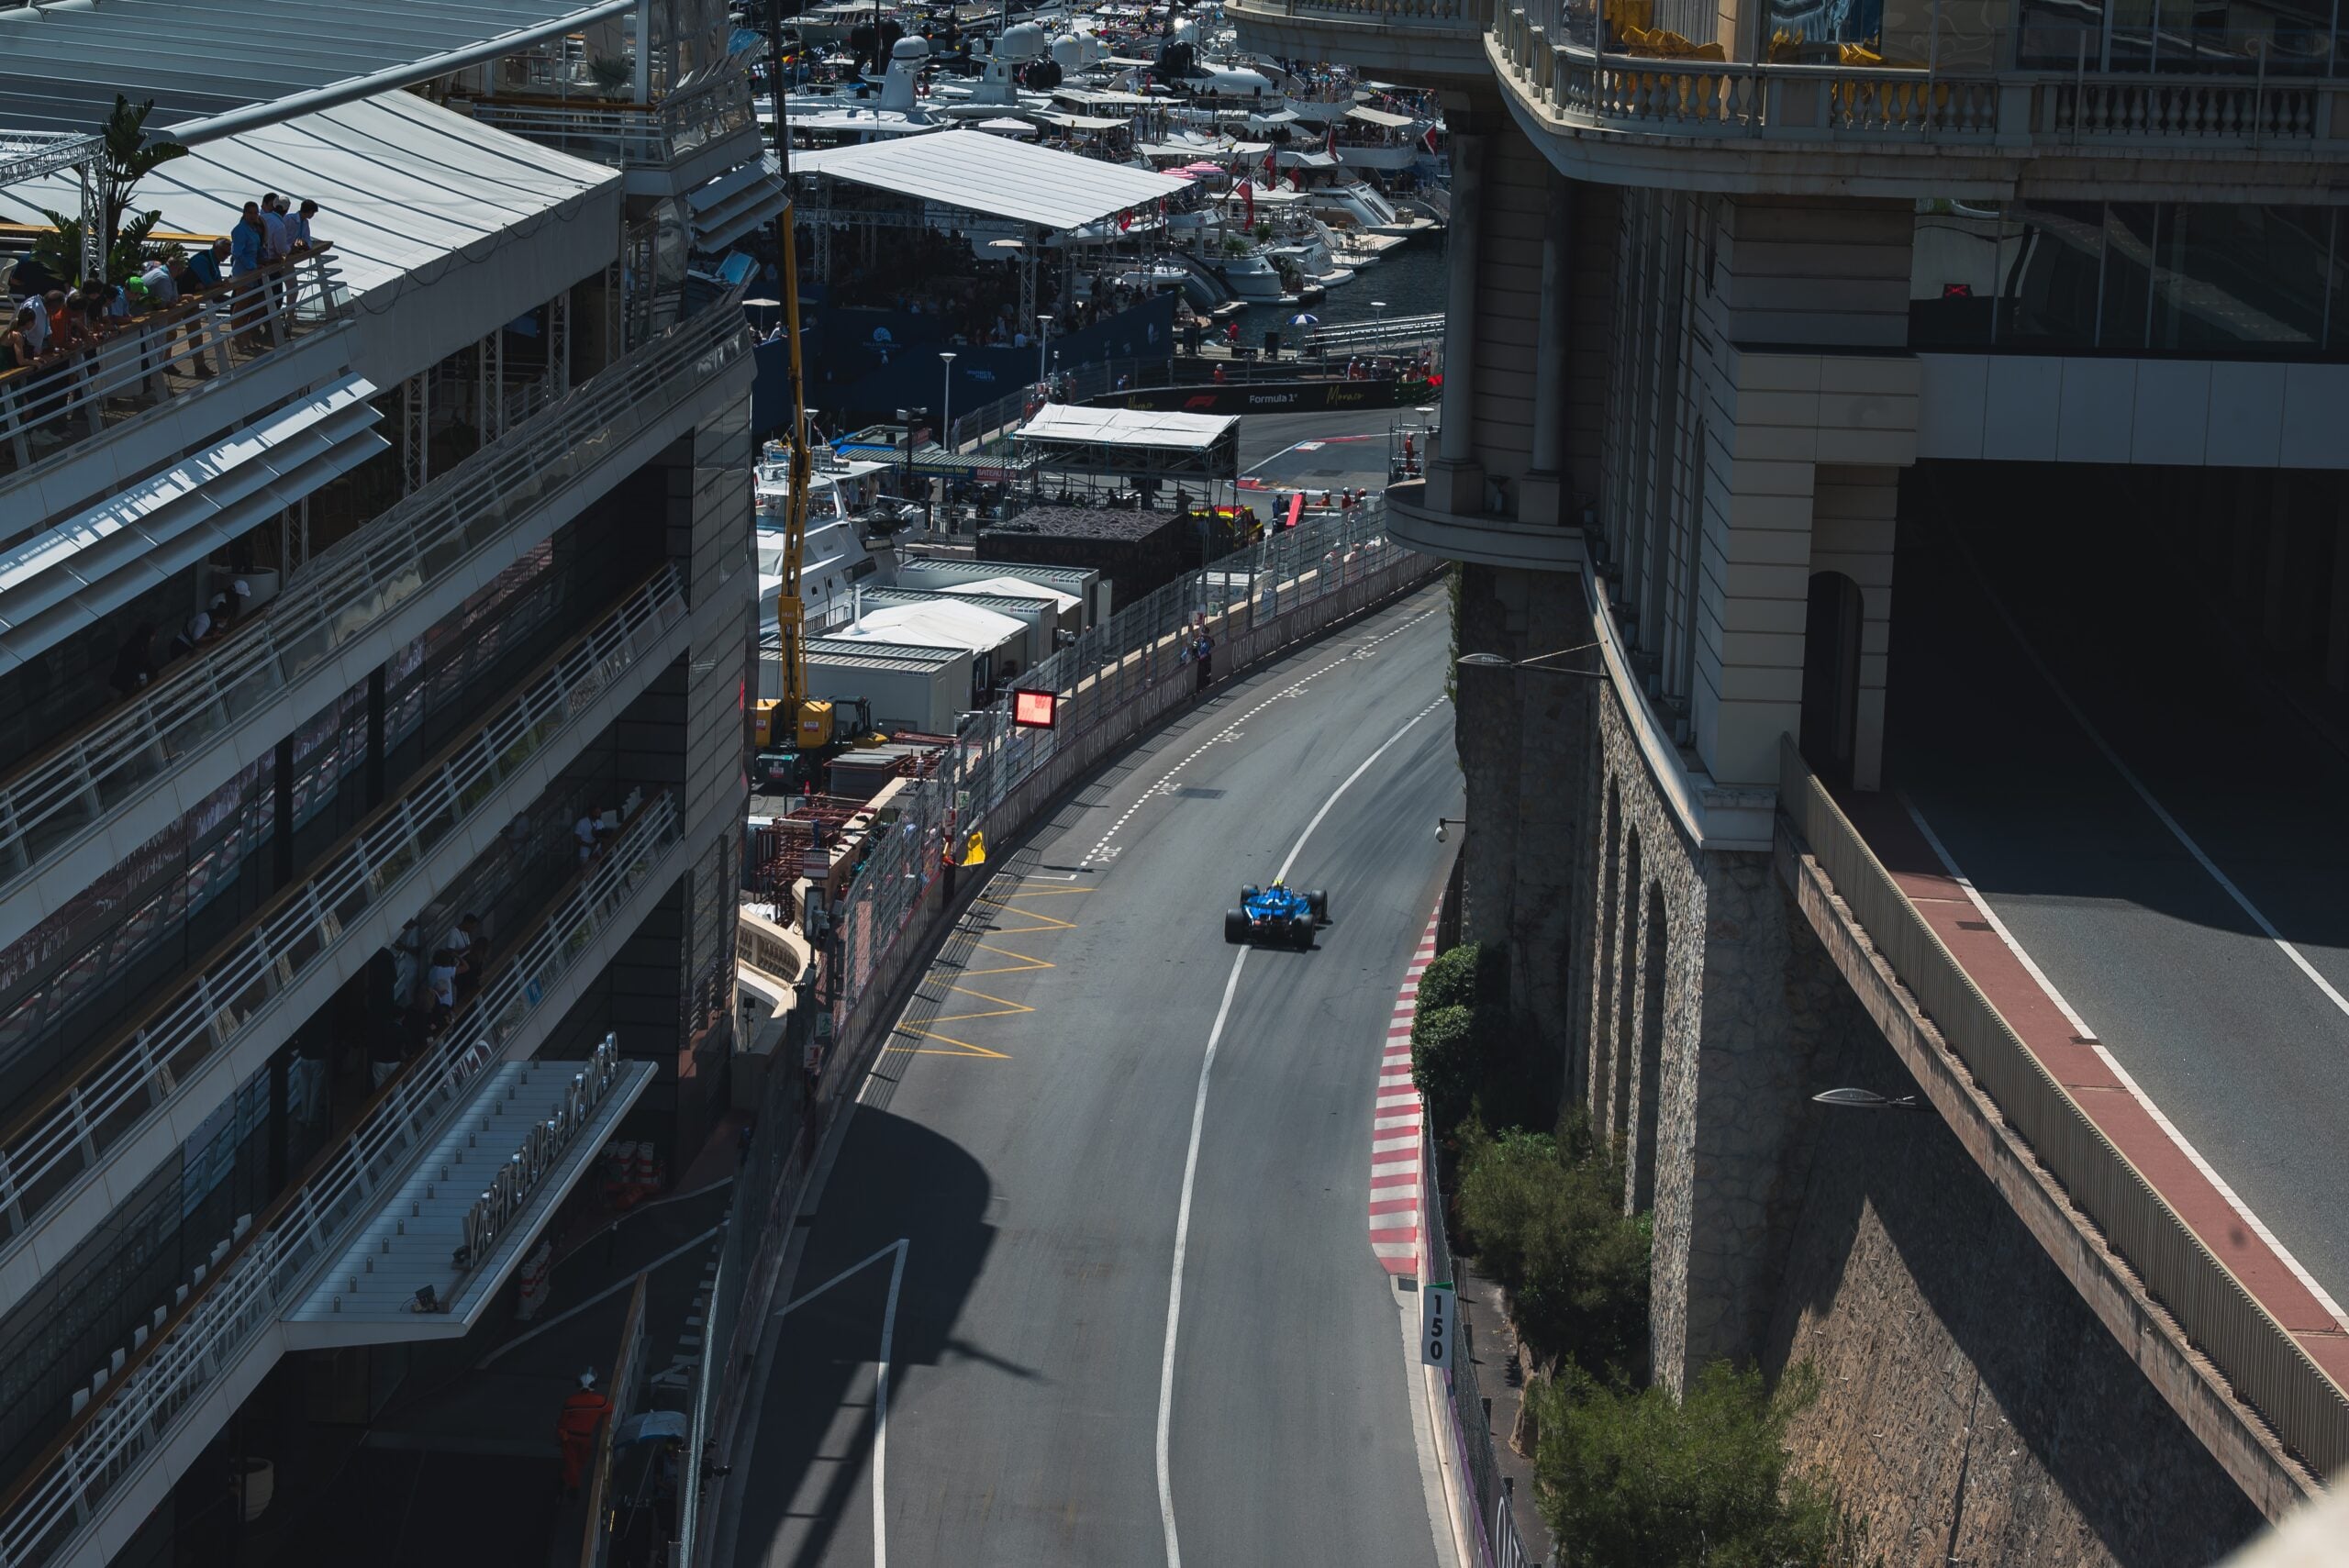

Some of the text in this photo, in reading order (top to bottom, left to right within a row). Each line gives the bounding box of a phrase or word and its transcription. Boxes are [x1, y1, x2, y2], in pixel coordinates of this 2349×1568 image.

[1249, 394, 1288, 405] Formula
[1291, 593, 1338, 639] QATAR AIRWAYS
[1231, 620, 1282, 670] QATAR AIRWAYS
[1139, 669, 1187, 730] QATAR AIRWAYS
[512, 1119, 549, 1205] CLUB
[565, 1030, 618, 1138] MONACO
[1430, 1295, 1443, 1361] 150
